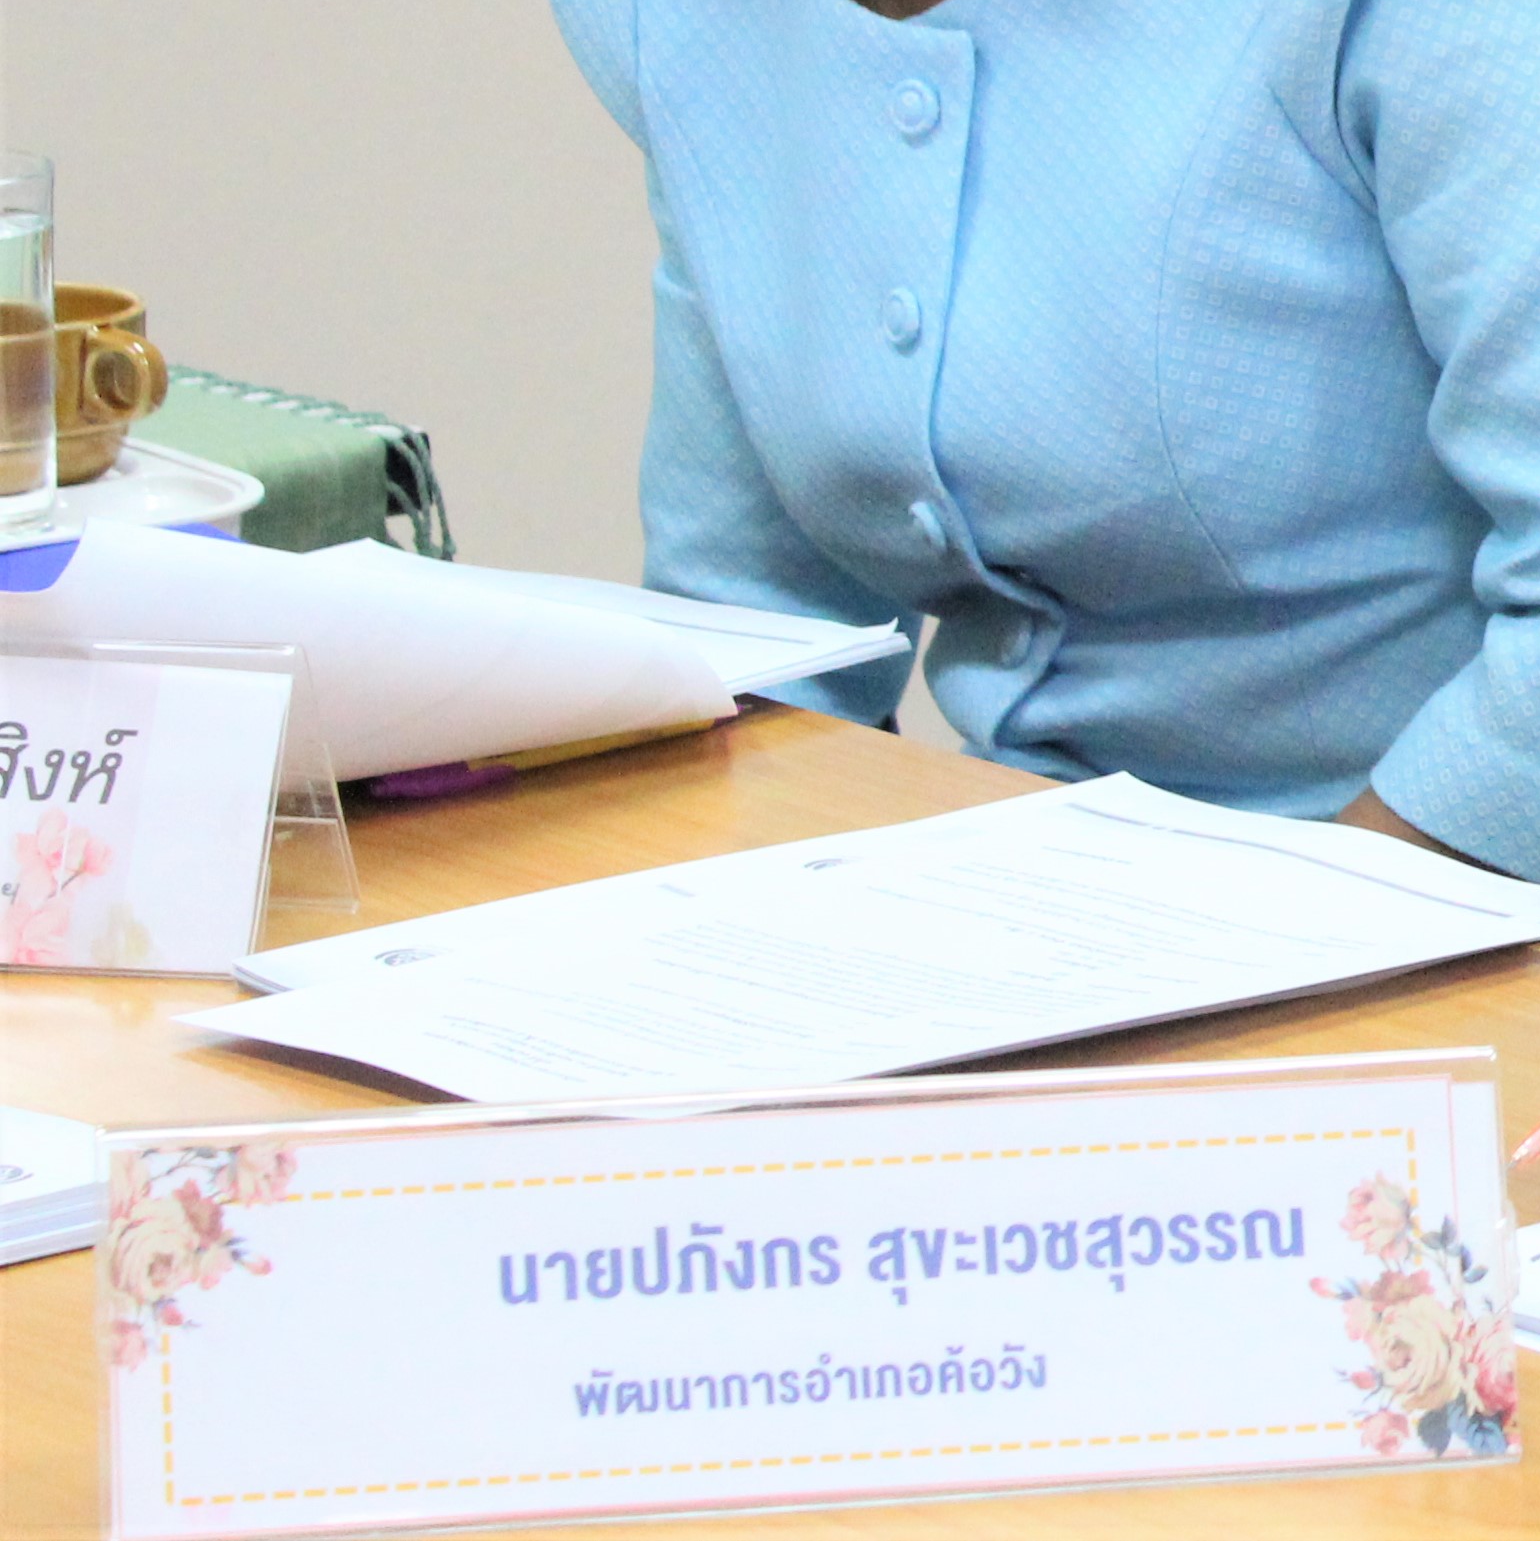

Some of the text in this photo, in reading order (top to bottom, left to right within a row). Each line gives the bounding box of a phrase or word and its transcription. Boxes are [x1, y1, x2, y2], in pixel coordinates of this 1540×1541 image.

[499, 1207, 1305, 1306] นายปภังกร สุขะเวชสุวรรณ
[573, 1343, 1047, 1418] พัฒนาการอำเภอค้อวัง
